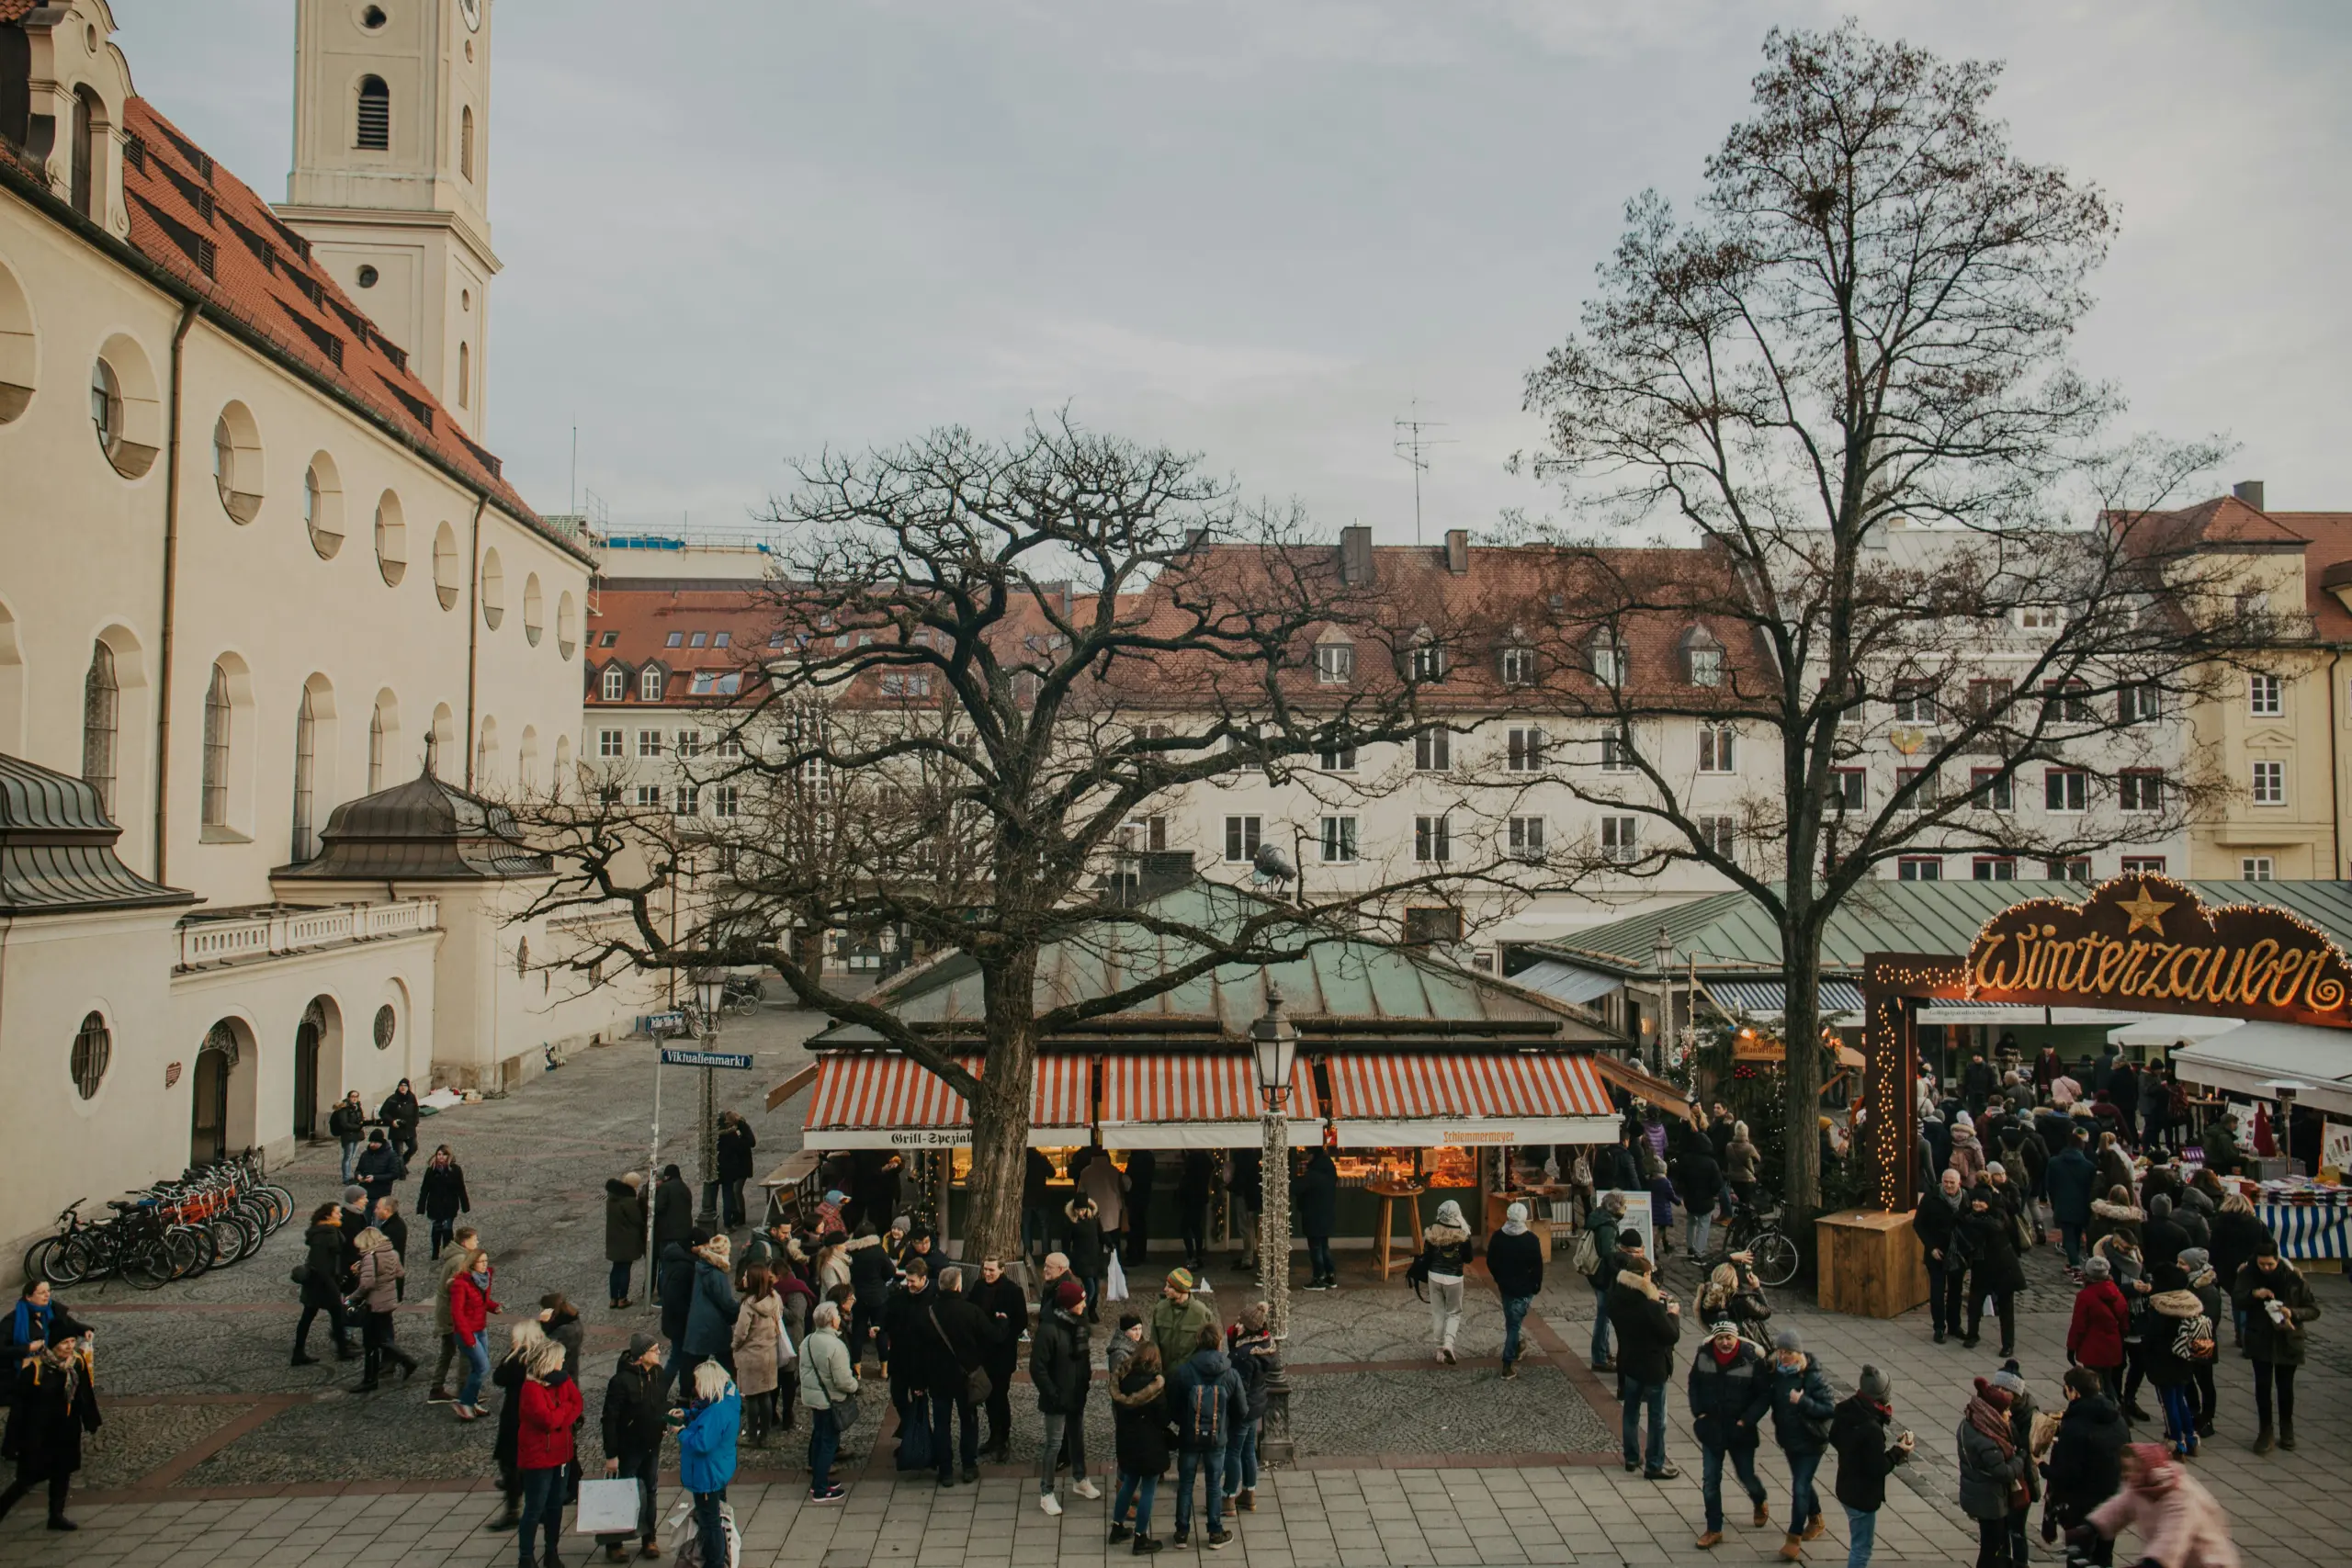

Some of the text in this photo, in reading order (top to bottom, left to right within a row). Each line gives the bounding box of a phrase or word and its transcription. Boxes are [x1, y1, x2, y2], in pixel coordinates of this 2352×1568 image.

[1975, 923, 2345, 1011] Winterzauber
[667, 1050, 745, 1067] Viktualienmarkt
[1443, 1131, 1515, 1143] Schlemmermeyer
